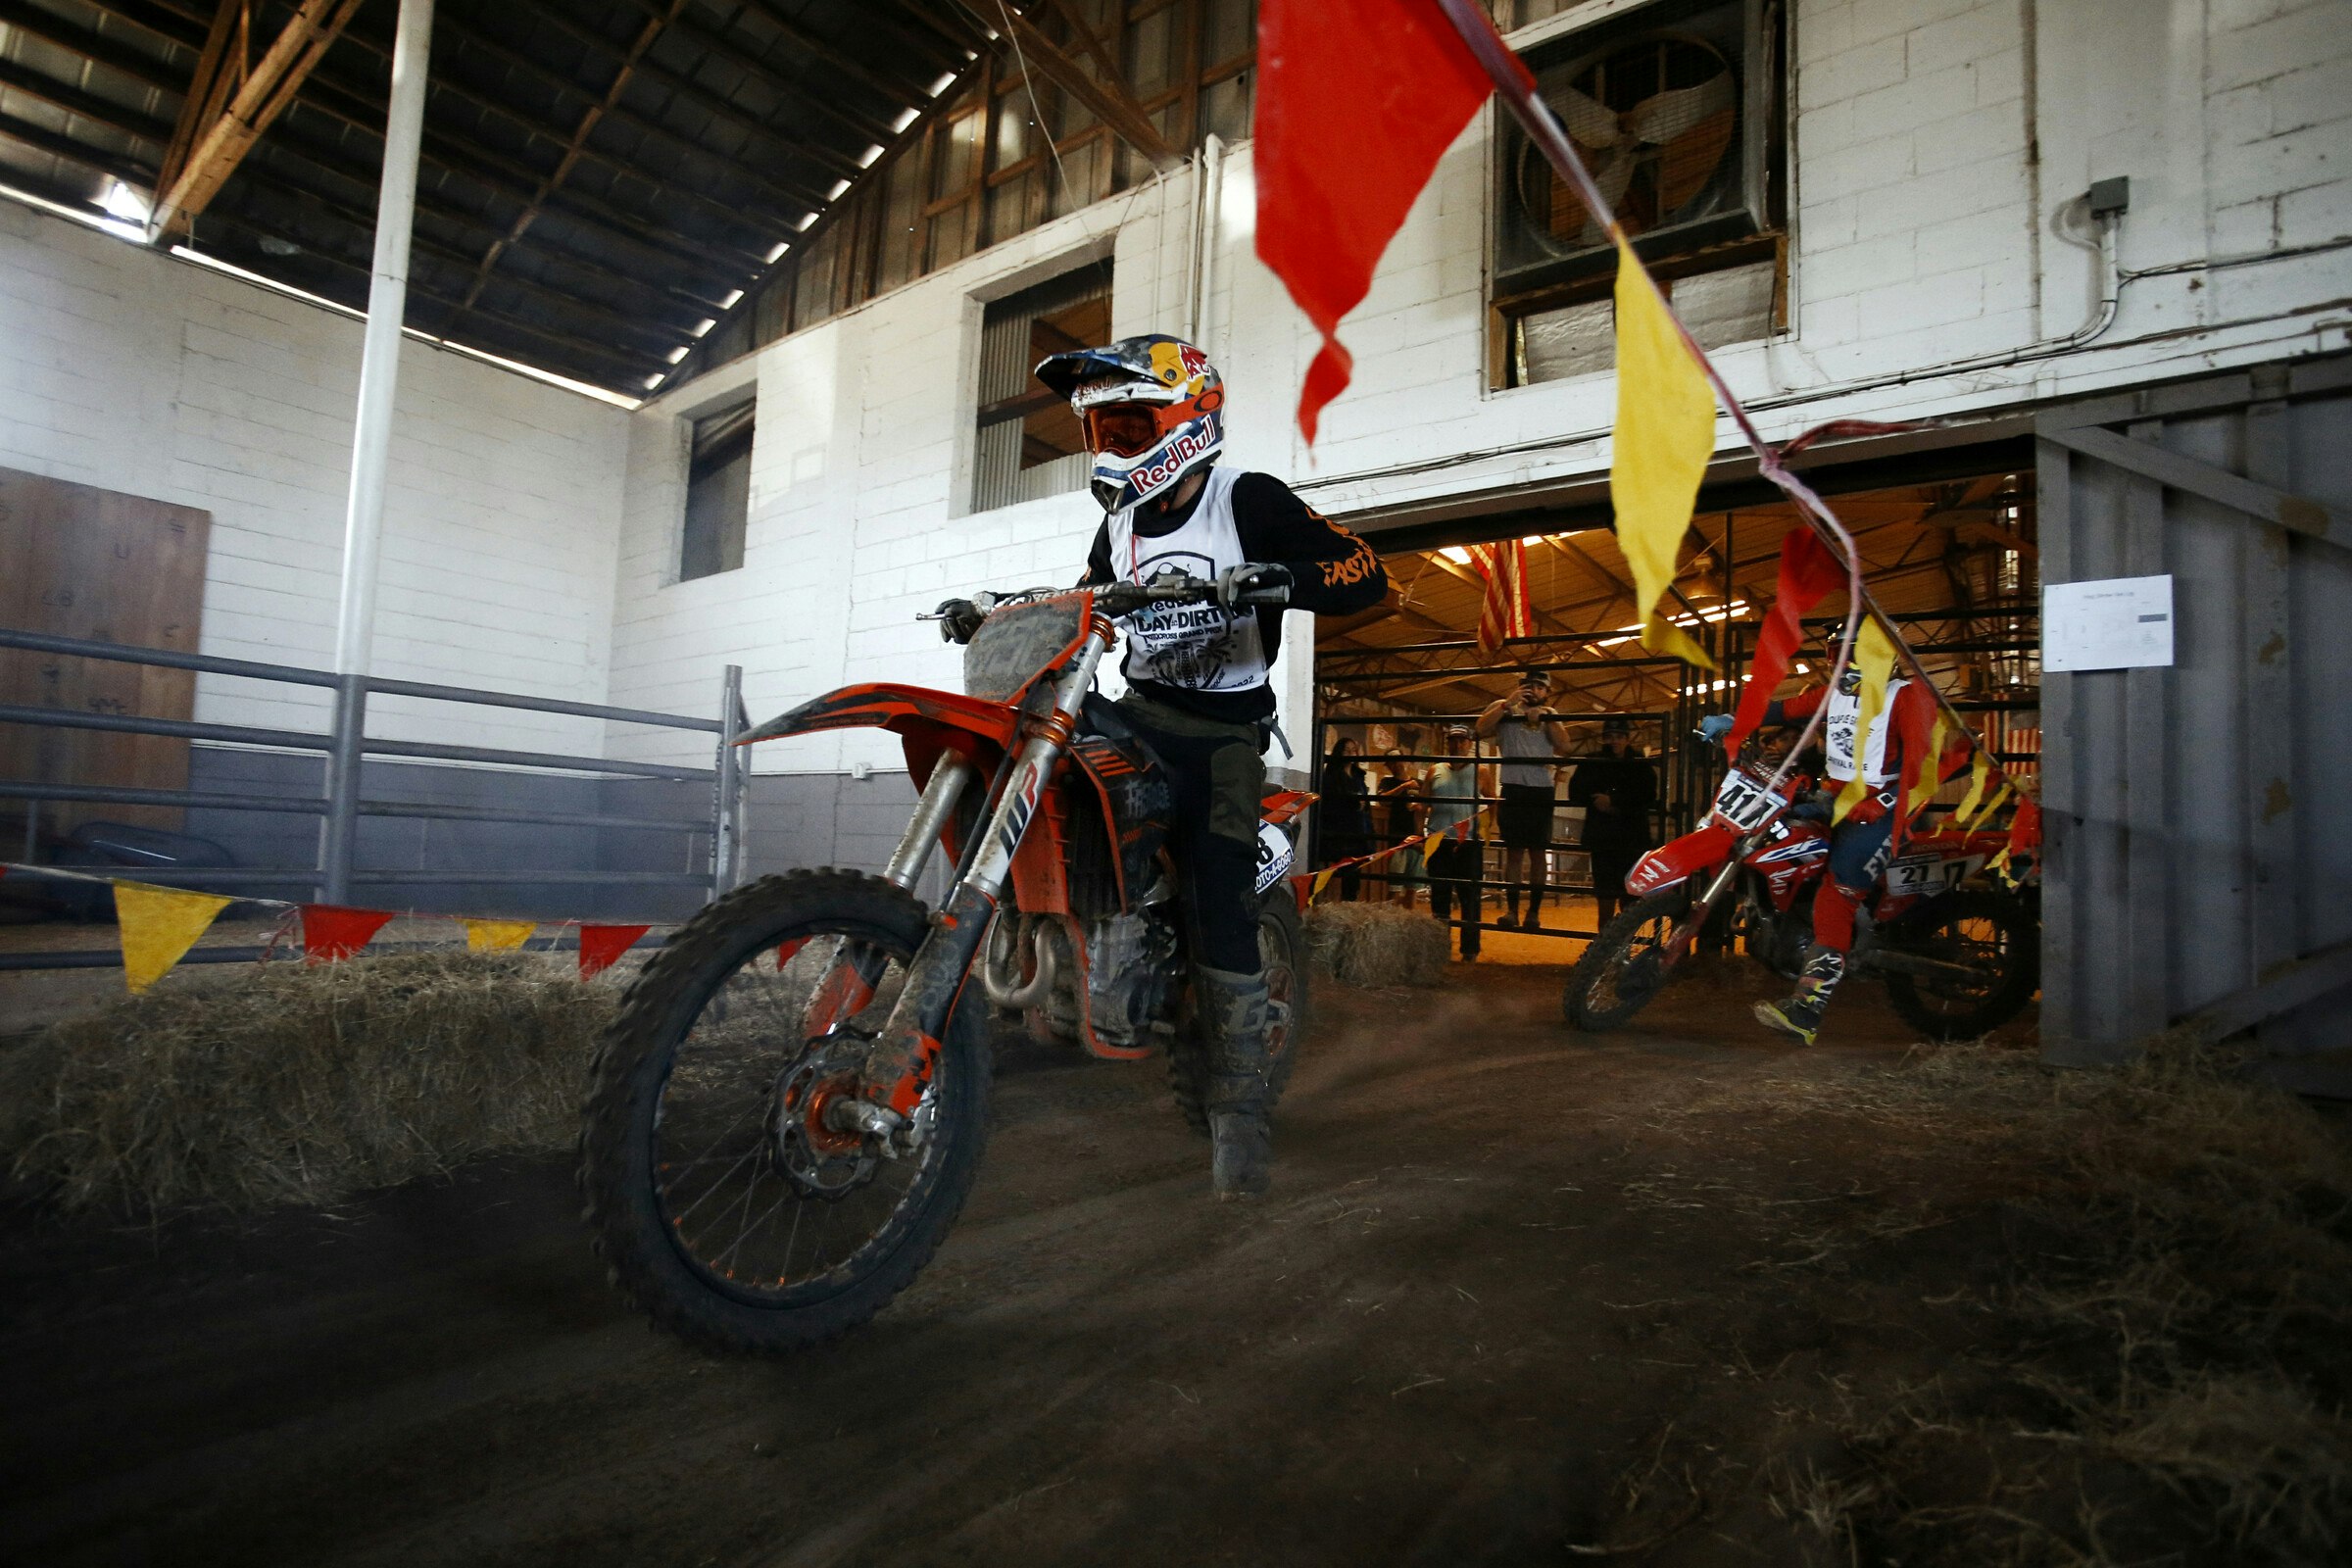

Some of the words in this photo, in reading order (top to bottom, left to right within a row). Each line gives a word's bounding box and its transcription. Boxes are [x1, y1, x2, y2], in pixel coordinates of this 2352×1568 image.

[1136, 613, 1174, 632] DAY
[1177, 607, 1221, 629] DIRT
[1178, 629, 1204, 640] GRAND
